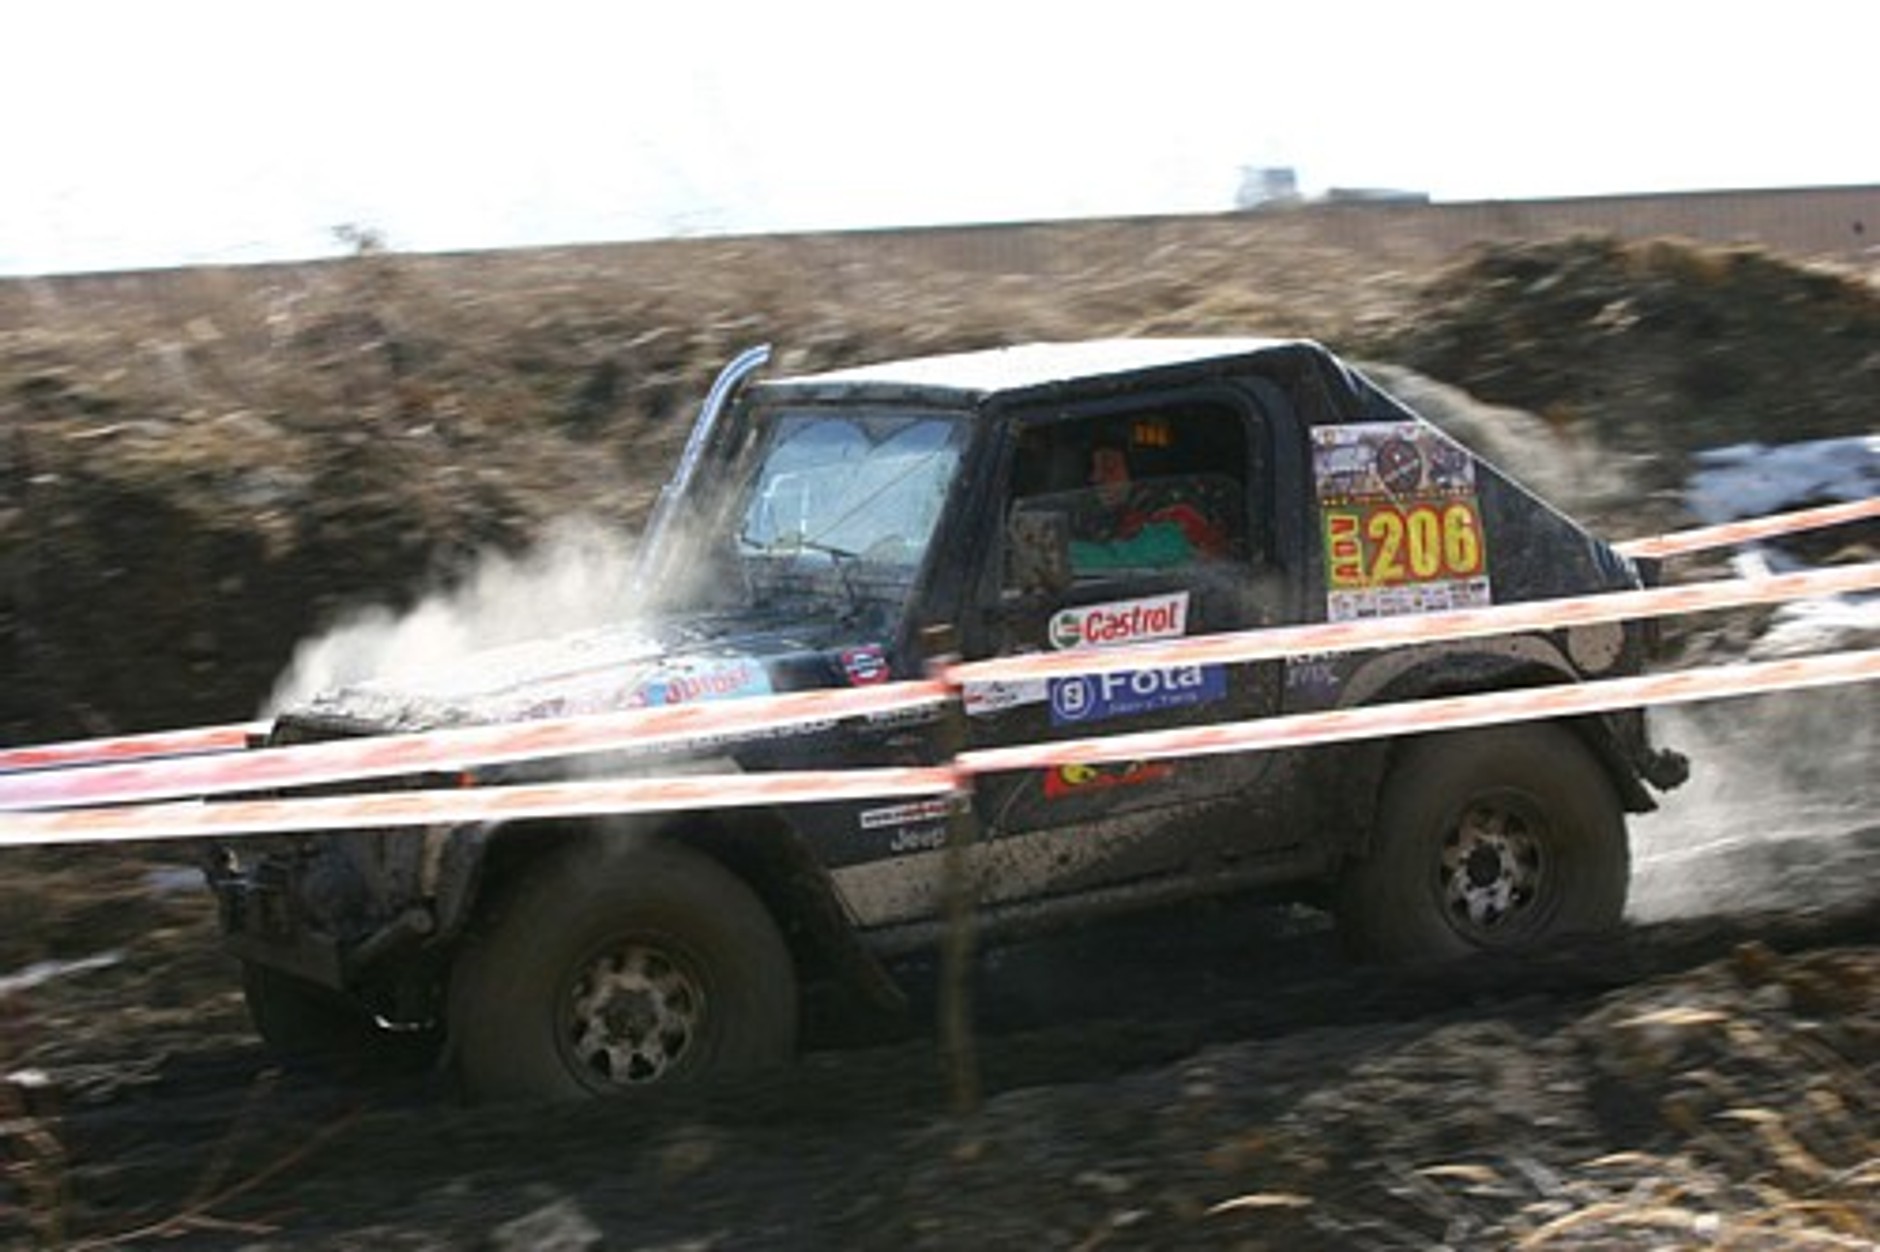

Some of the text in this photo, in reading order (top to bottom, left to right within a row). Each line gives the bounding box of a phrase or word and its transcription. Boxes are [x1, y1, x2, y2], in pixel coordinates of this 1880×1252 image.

[1330, 517, 1359, 580] ADV
[1366, 502, 1483, 582] 206
[1085, 601, 1178, 643] Castrol
[1101, 665, 1203, 701] Fota
